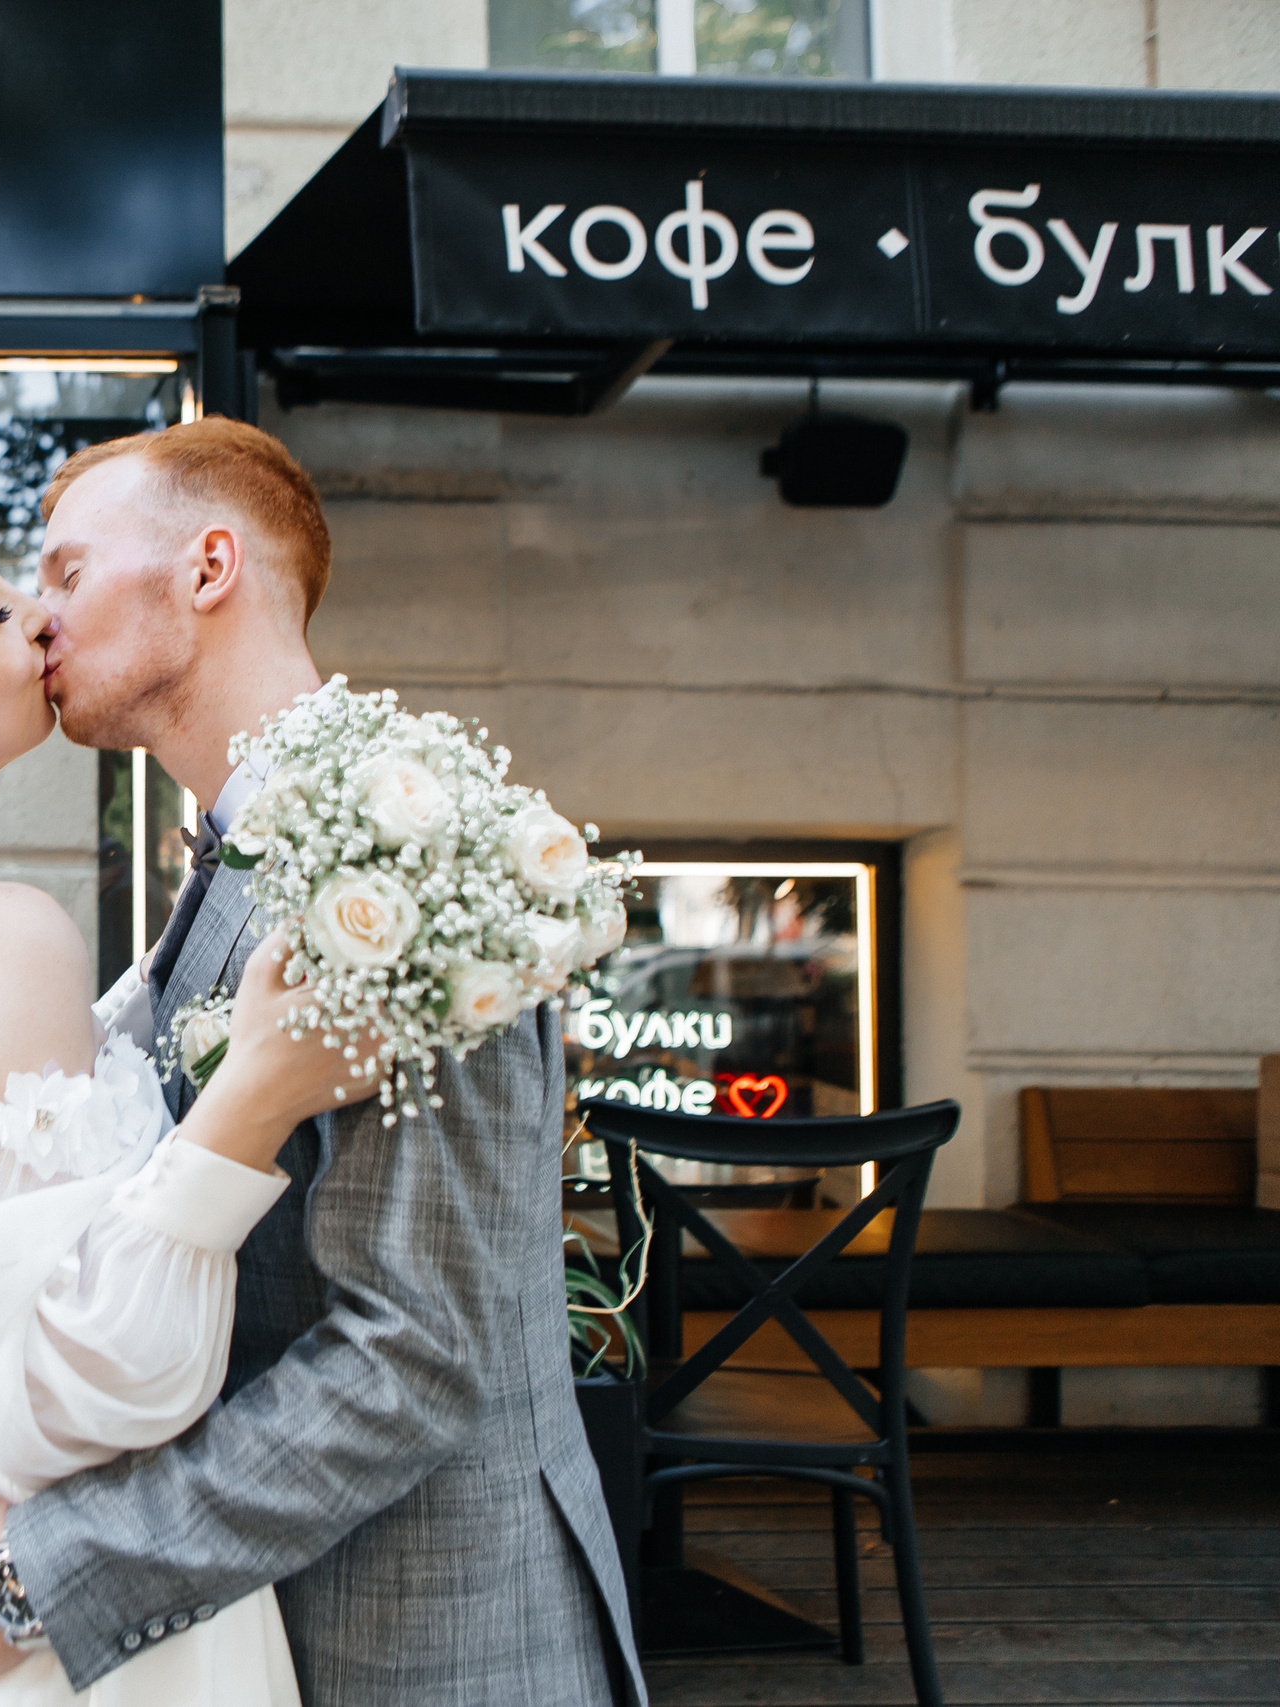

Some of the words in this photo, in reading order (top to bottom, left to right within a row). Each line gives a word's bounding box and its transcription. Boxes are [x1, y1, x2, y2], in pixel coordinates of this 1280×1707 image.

[502, 180, 815, 310] кофе
[969, 183, 1280, 315] булк
[578, 998, 733, 1059] булки
